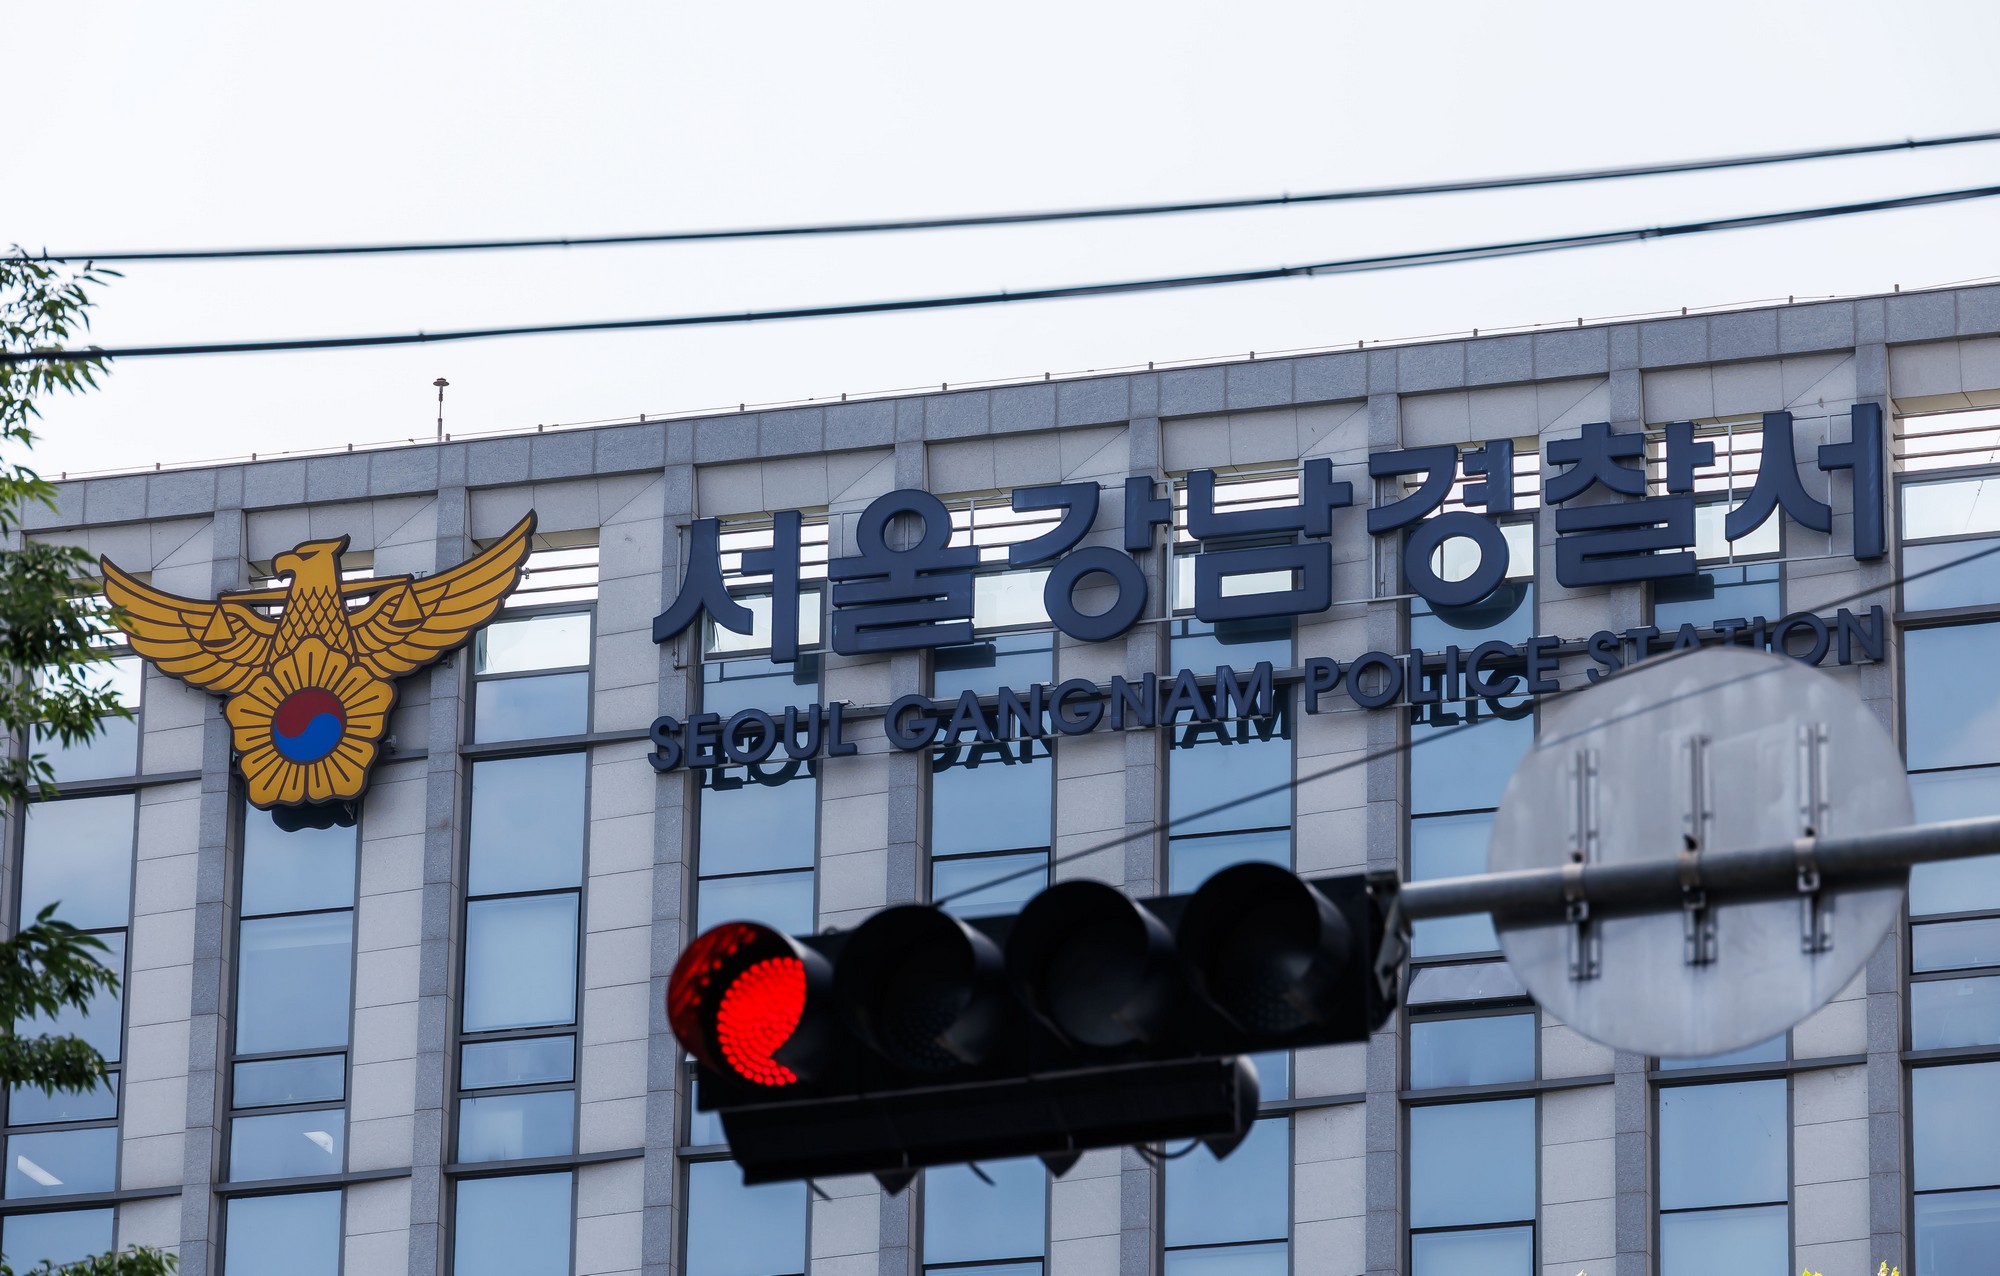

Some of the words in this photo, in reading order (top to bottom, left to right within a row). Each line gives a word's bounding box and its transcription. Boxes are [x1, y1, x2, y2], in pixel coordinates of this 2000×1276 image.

[653, 402, 1887, 663] 서울강남경찰서
[648, 702, 858, 772] SEOUL
[884, 661, 1274, 751] GANGNAM
[1305, 635, 1561, 715] POLICE
